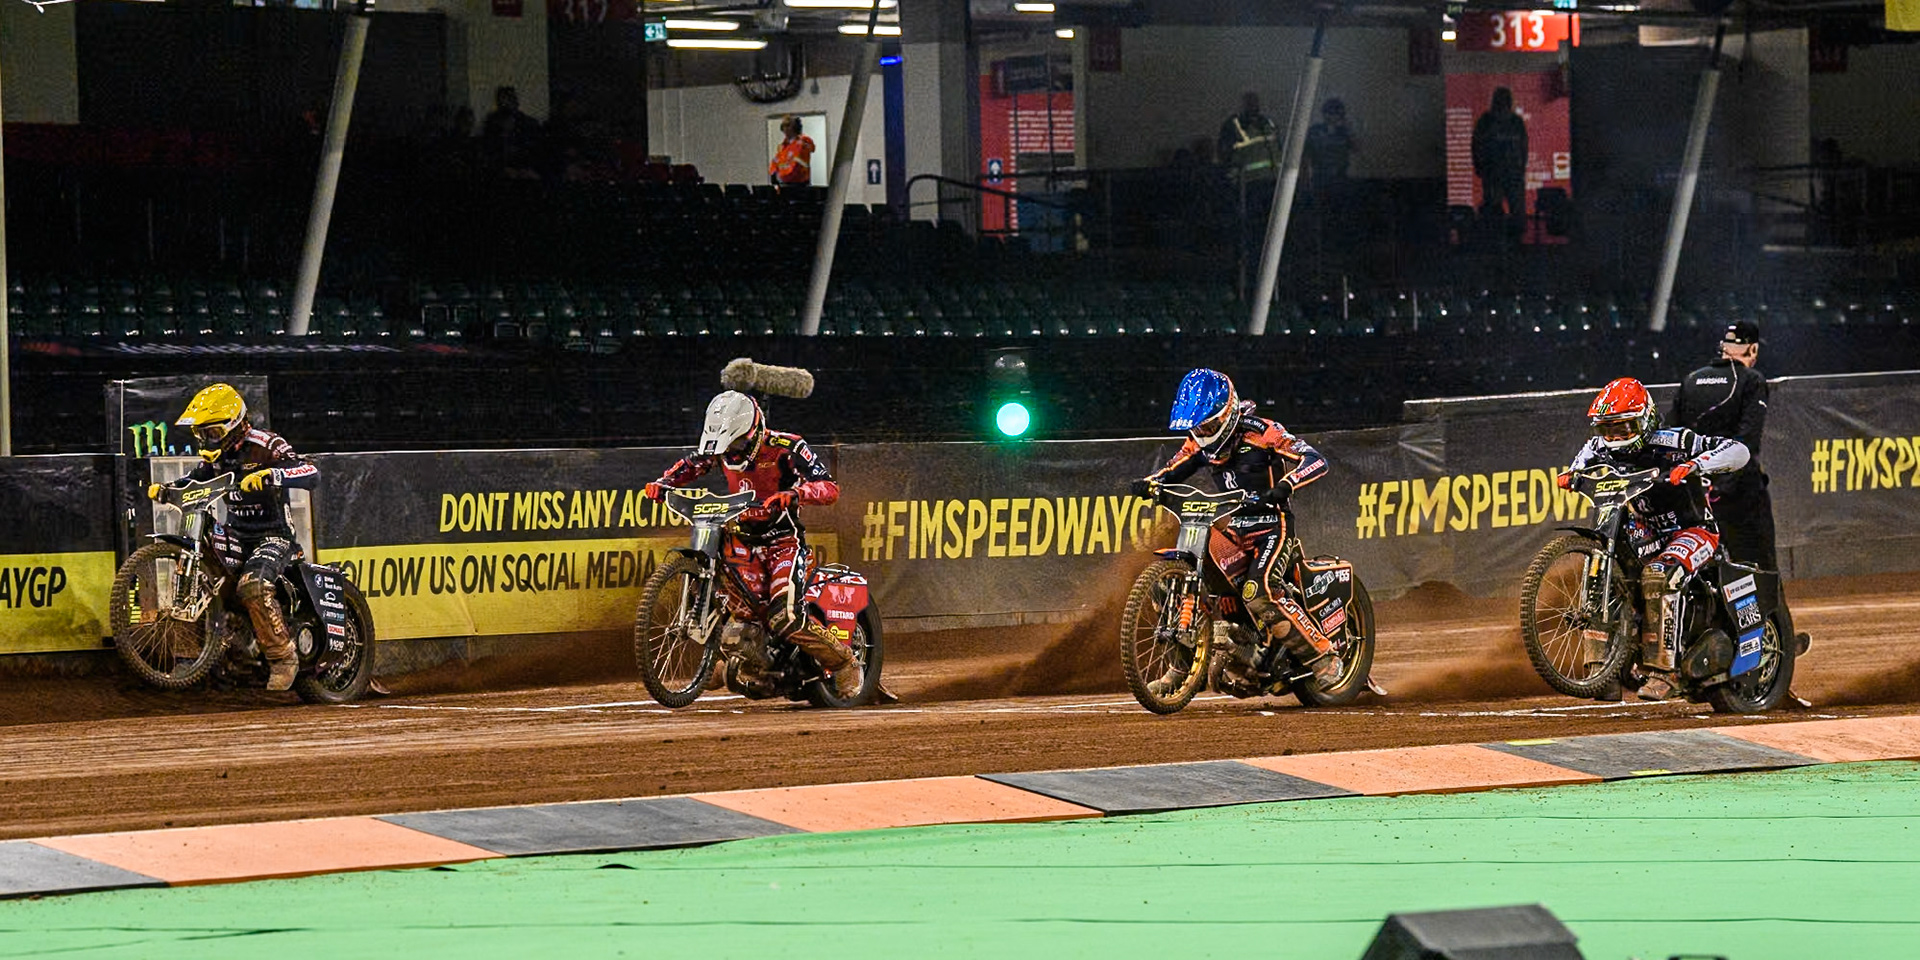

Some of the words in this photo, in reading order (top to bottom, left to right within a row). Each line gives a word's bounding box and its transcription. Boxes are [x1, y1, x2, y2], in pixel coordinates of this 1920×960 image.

[1490, 13, 1545, 48] 313
[1696, 376, 1729, 385] MARSHAL
[440, 492, 509, 533] DONT
[512, 491, 565, 531] MISS
[568, 490, 618, 529] ANY
[0, 566, 67, 609] AYGP
[429, 555, 457, 595] US
[460, 554, 498, 594] ON
[585, 550, 656, 589] MEDIA
[831, 610, 855, 620] BETARD
[1738, 611, 1762, 629] CARS
